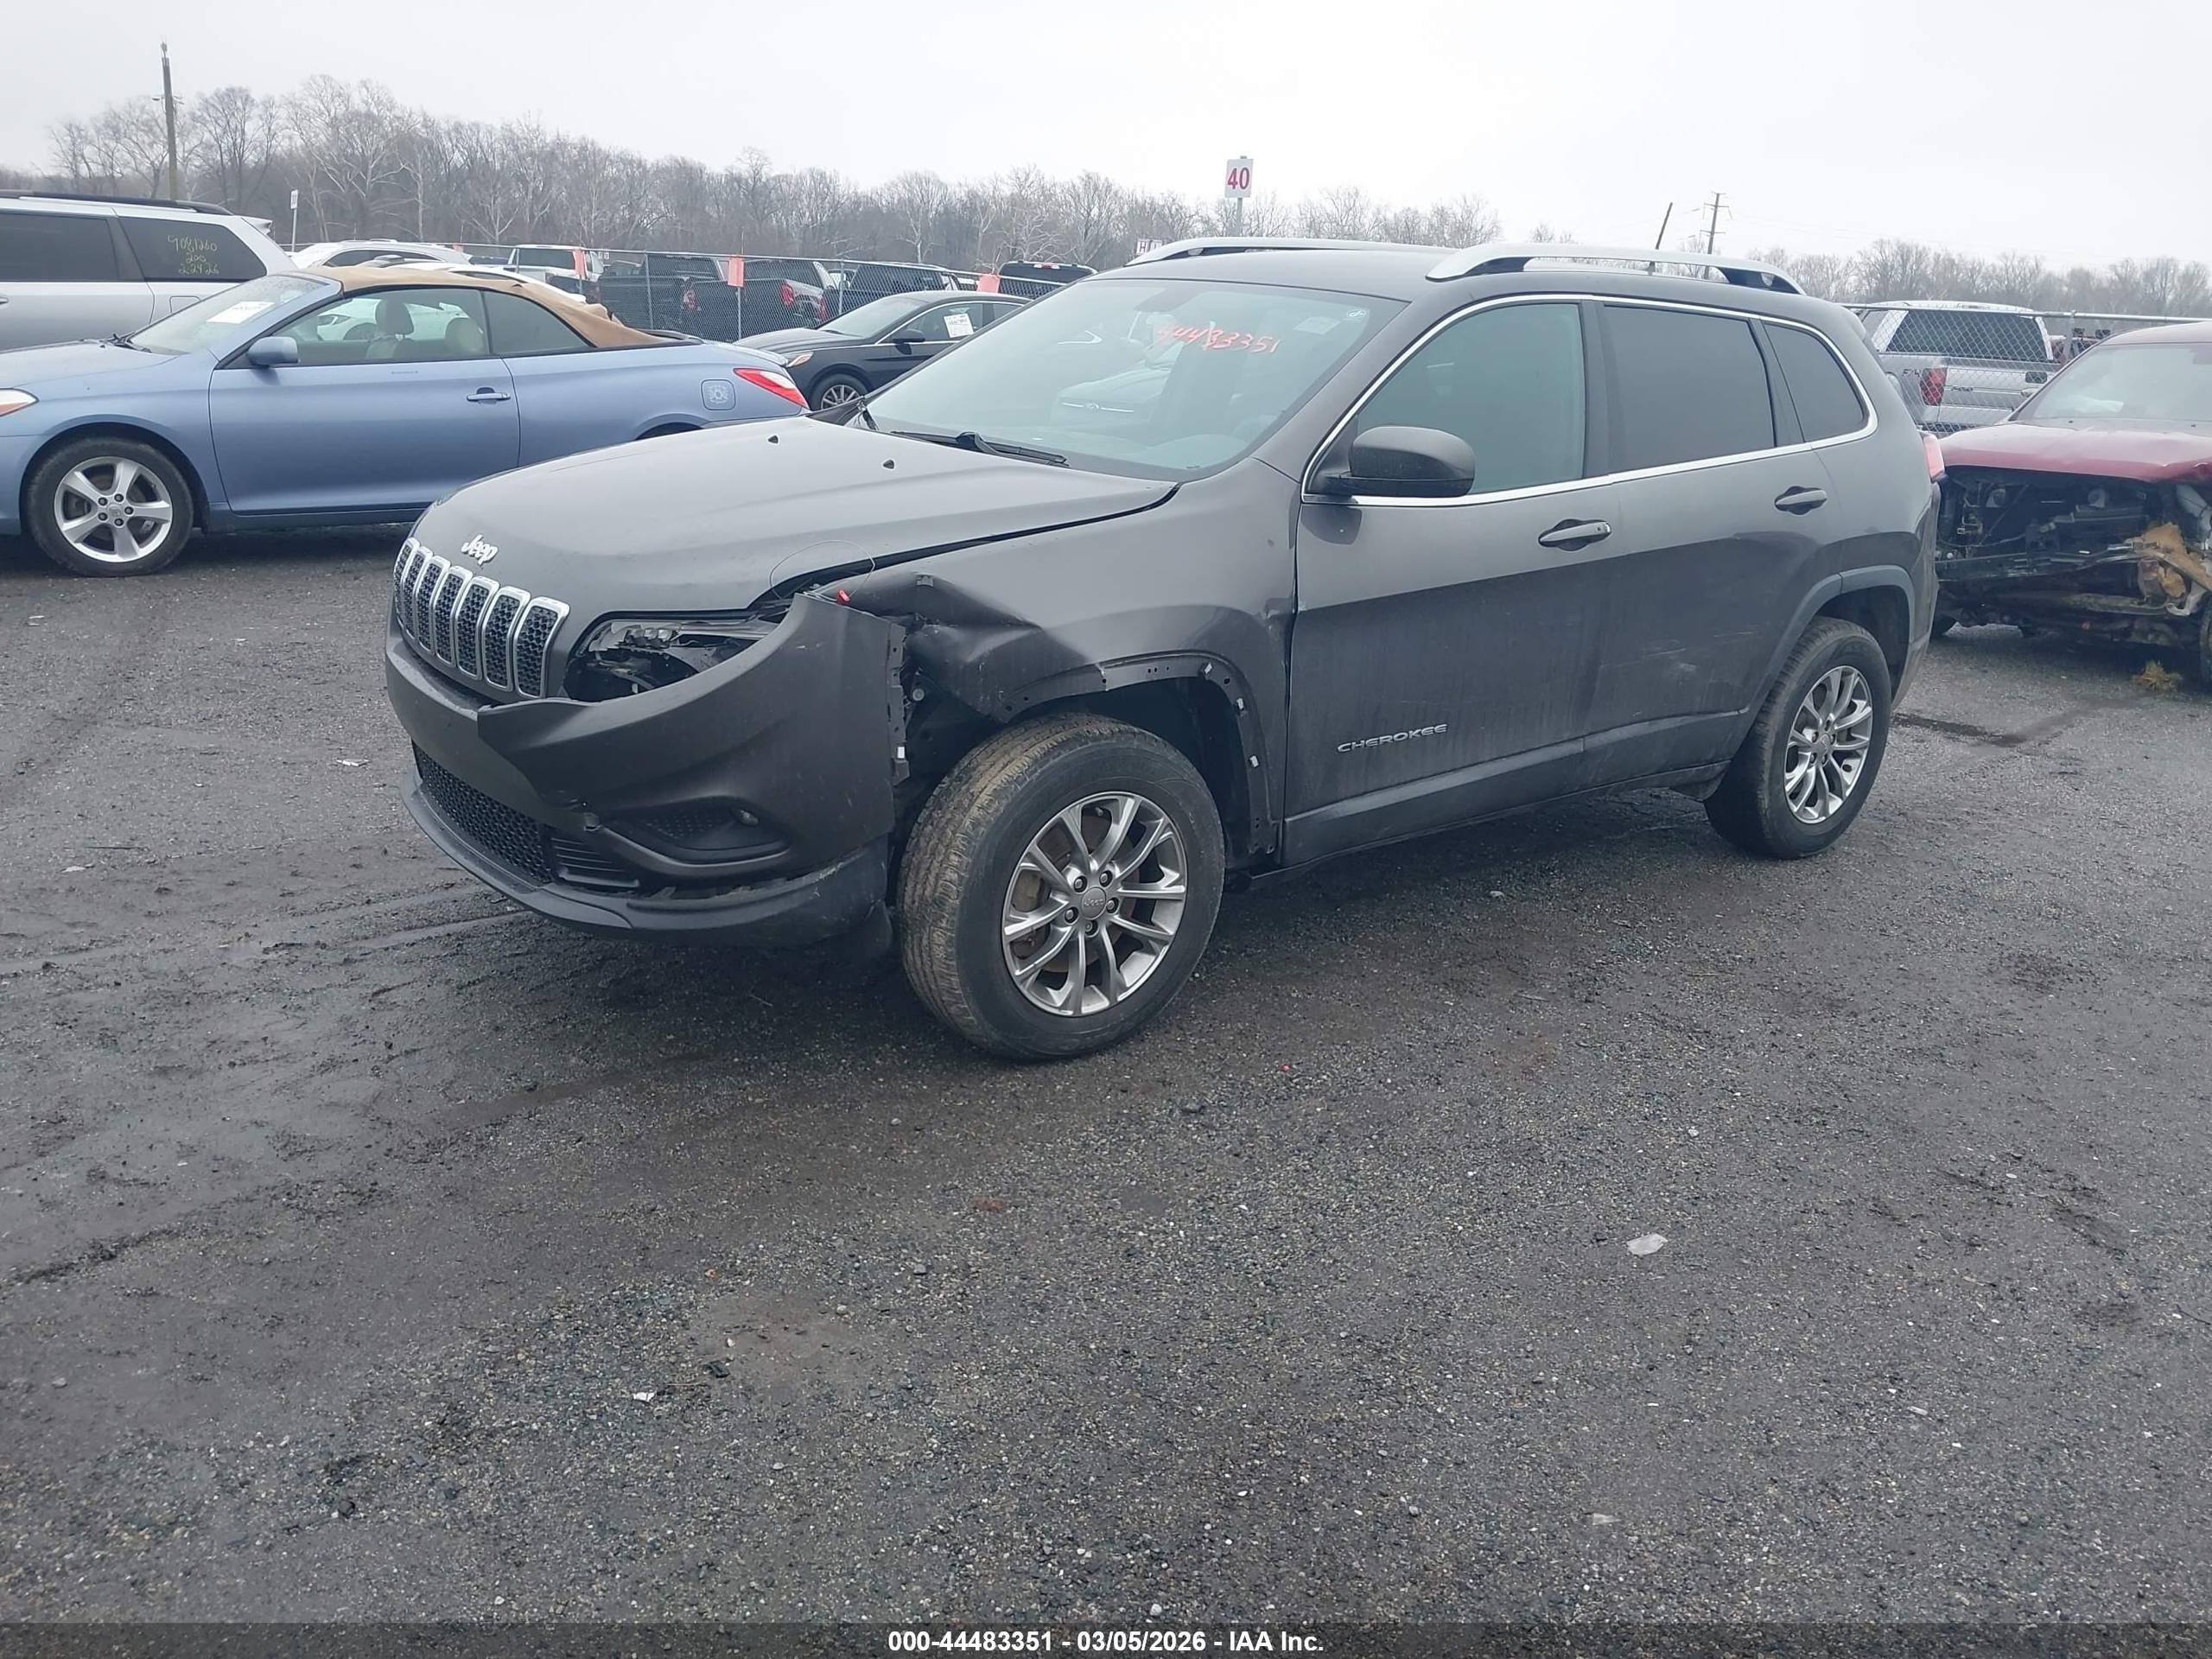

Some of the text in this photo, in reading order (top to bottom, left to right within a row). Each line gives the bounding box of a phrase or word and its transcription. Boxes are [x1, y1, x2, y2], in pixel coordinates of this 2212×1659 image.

[1227, 167, 1250, 190] 40
[461, 534, 499, 566] Jeep
[1337, 723, 1447, 753] CHEROKEE
